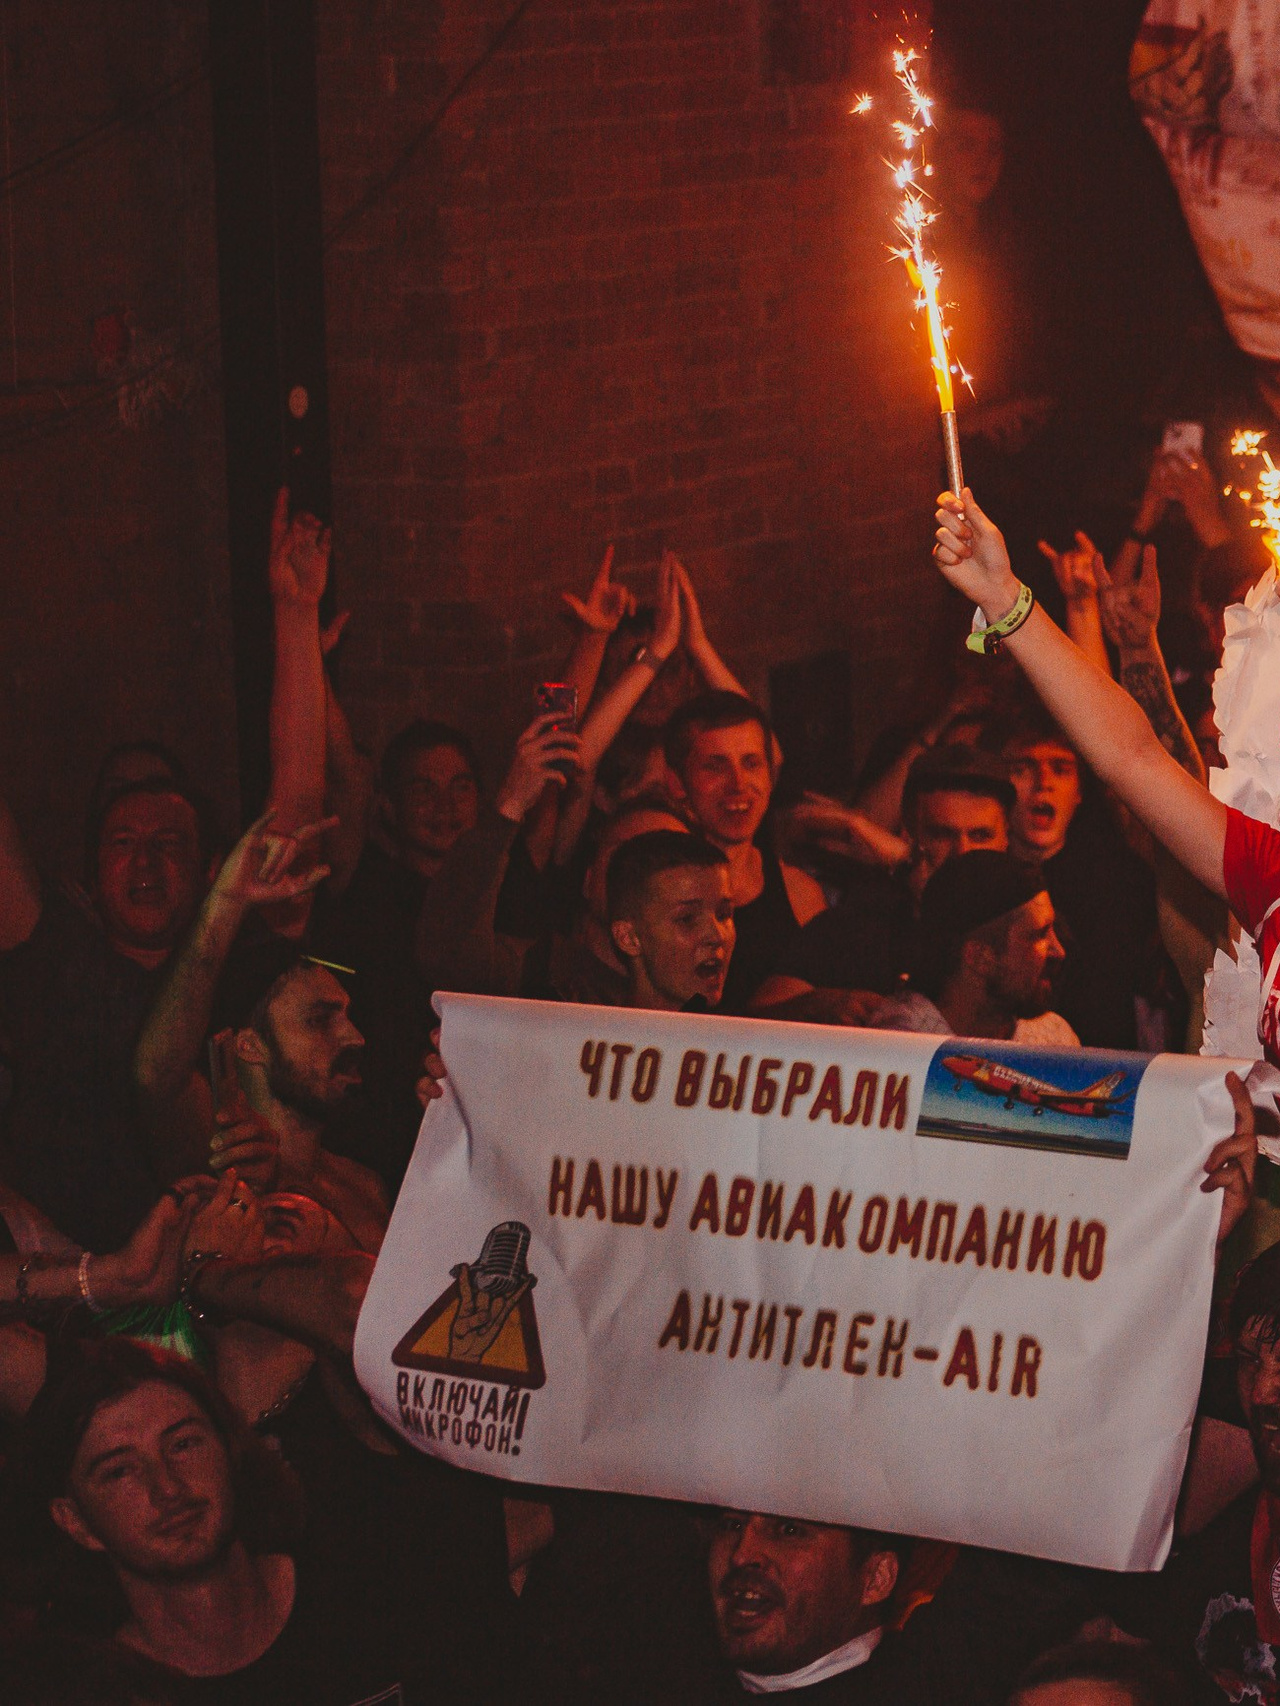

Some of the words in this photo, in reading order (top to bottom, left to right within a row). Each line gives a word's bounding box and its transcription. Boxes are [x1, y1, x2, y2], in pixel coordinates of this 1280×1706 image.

[580, 1040, 662, 1102] ЧТО
[674, 1049, 910, 1131] ВЫБРАЛИ
[548, 1155, 679, 1229] НАШУ
[689, 1172, 1107, 1281] АВИАКОМПАНИЮ
